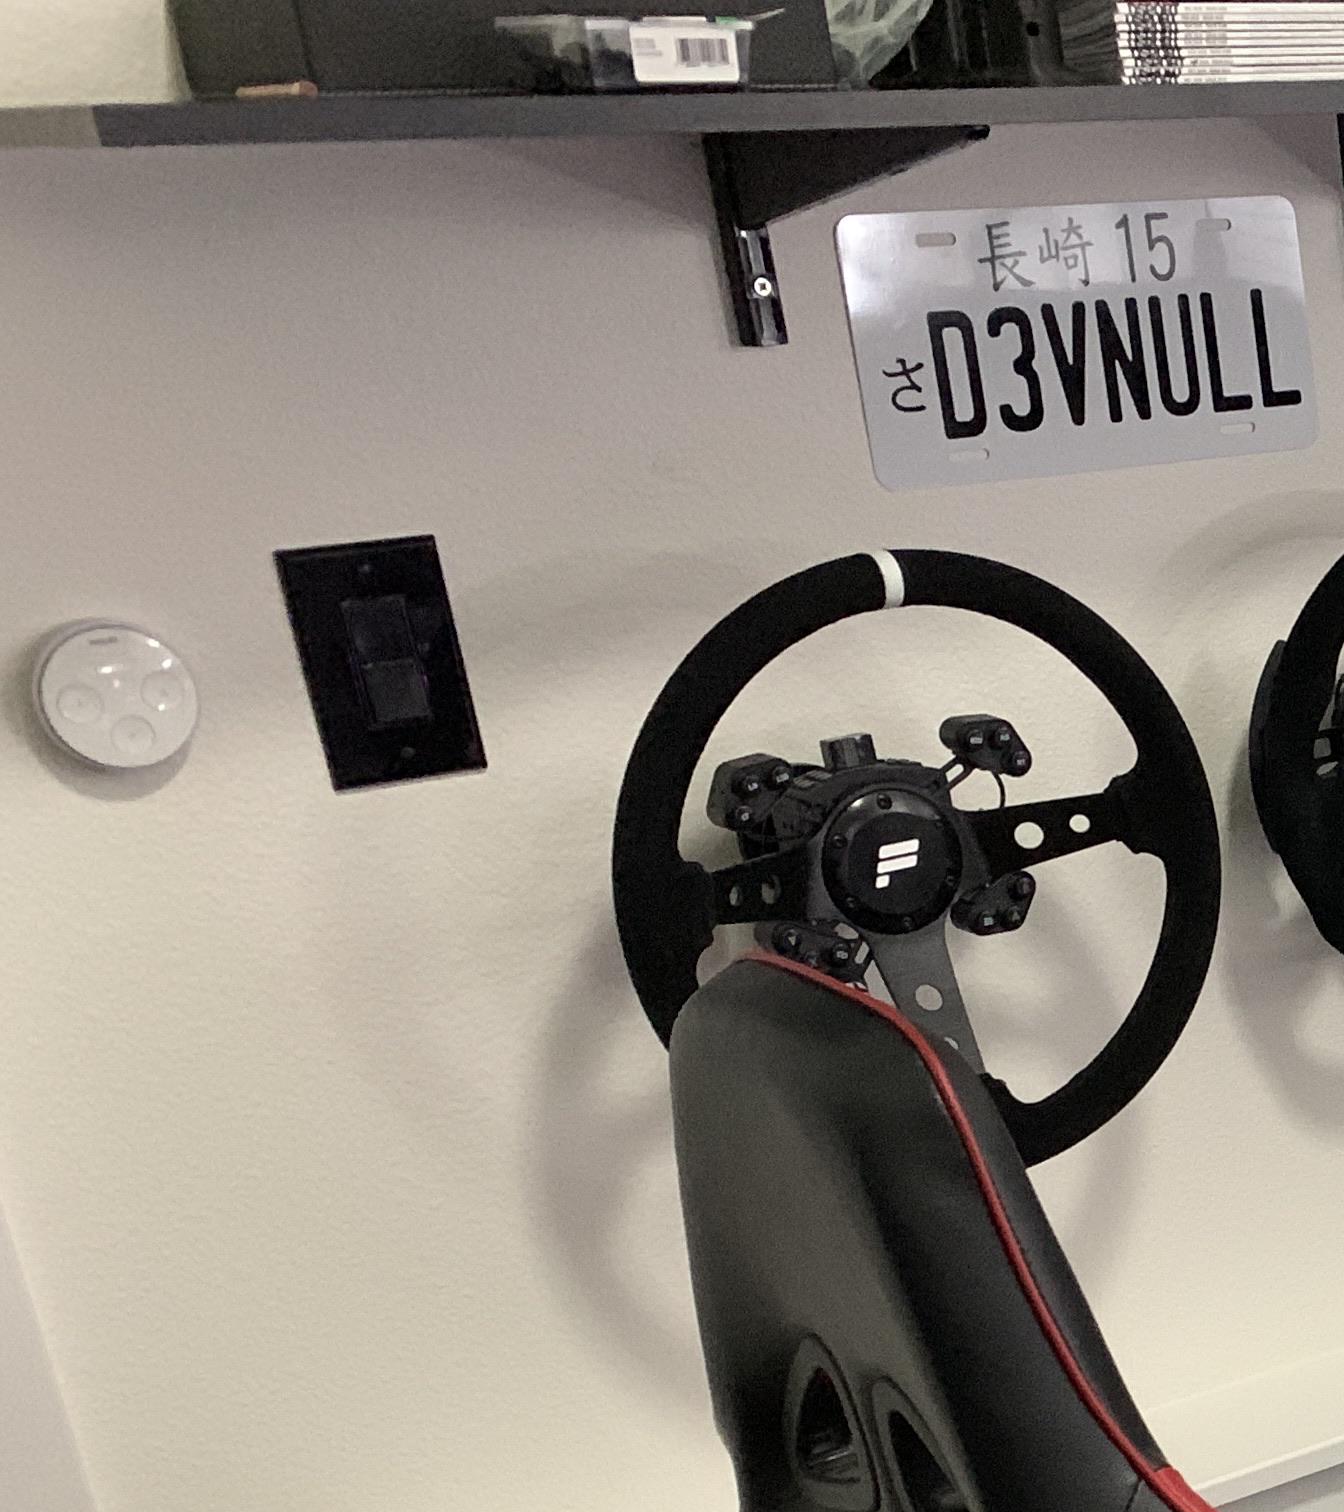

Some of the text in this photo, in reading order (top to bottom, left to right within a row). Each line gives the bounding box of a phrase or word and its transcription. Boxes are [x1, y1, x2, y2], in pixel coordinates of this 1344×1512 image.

[978, 212, 1175, 292] 長崎 15
[882, 288, 1302, 439] さ D3VNULL
